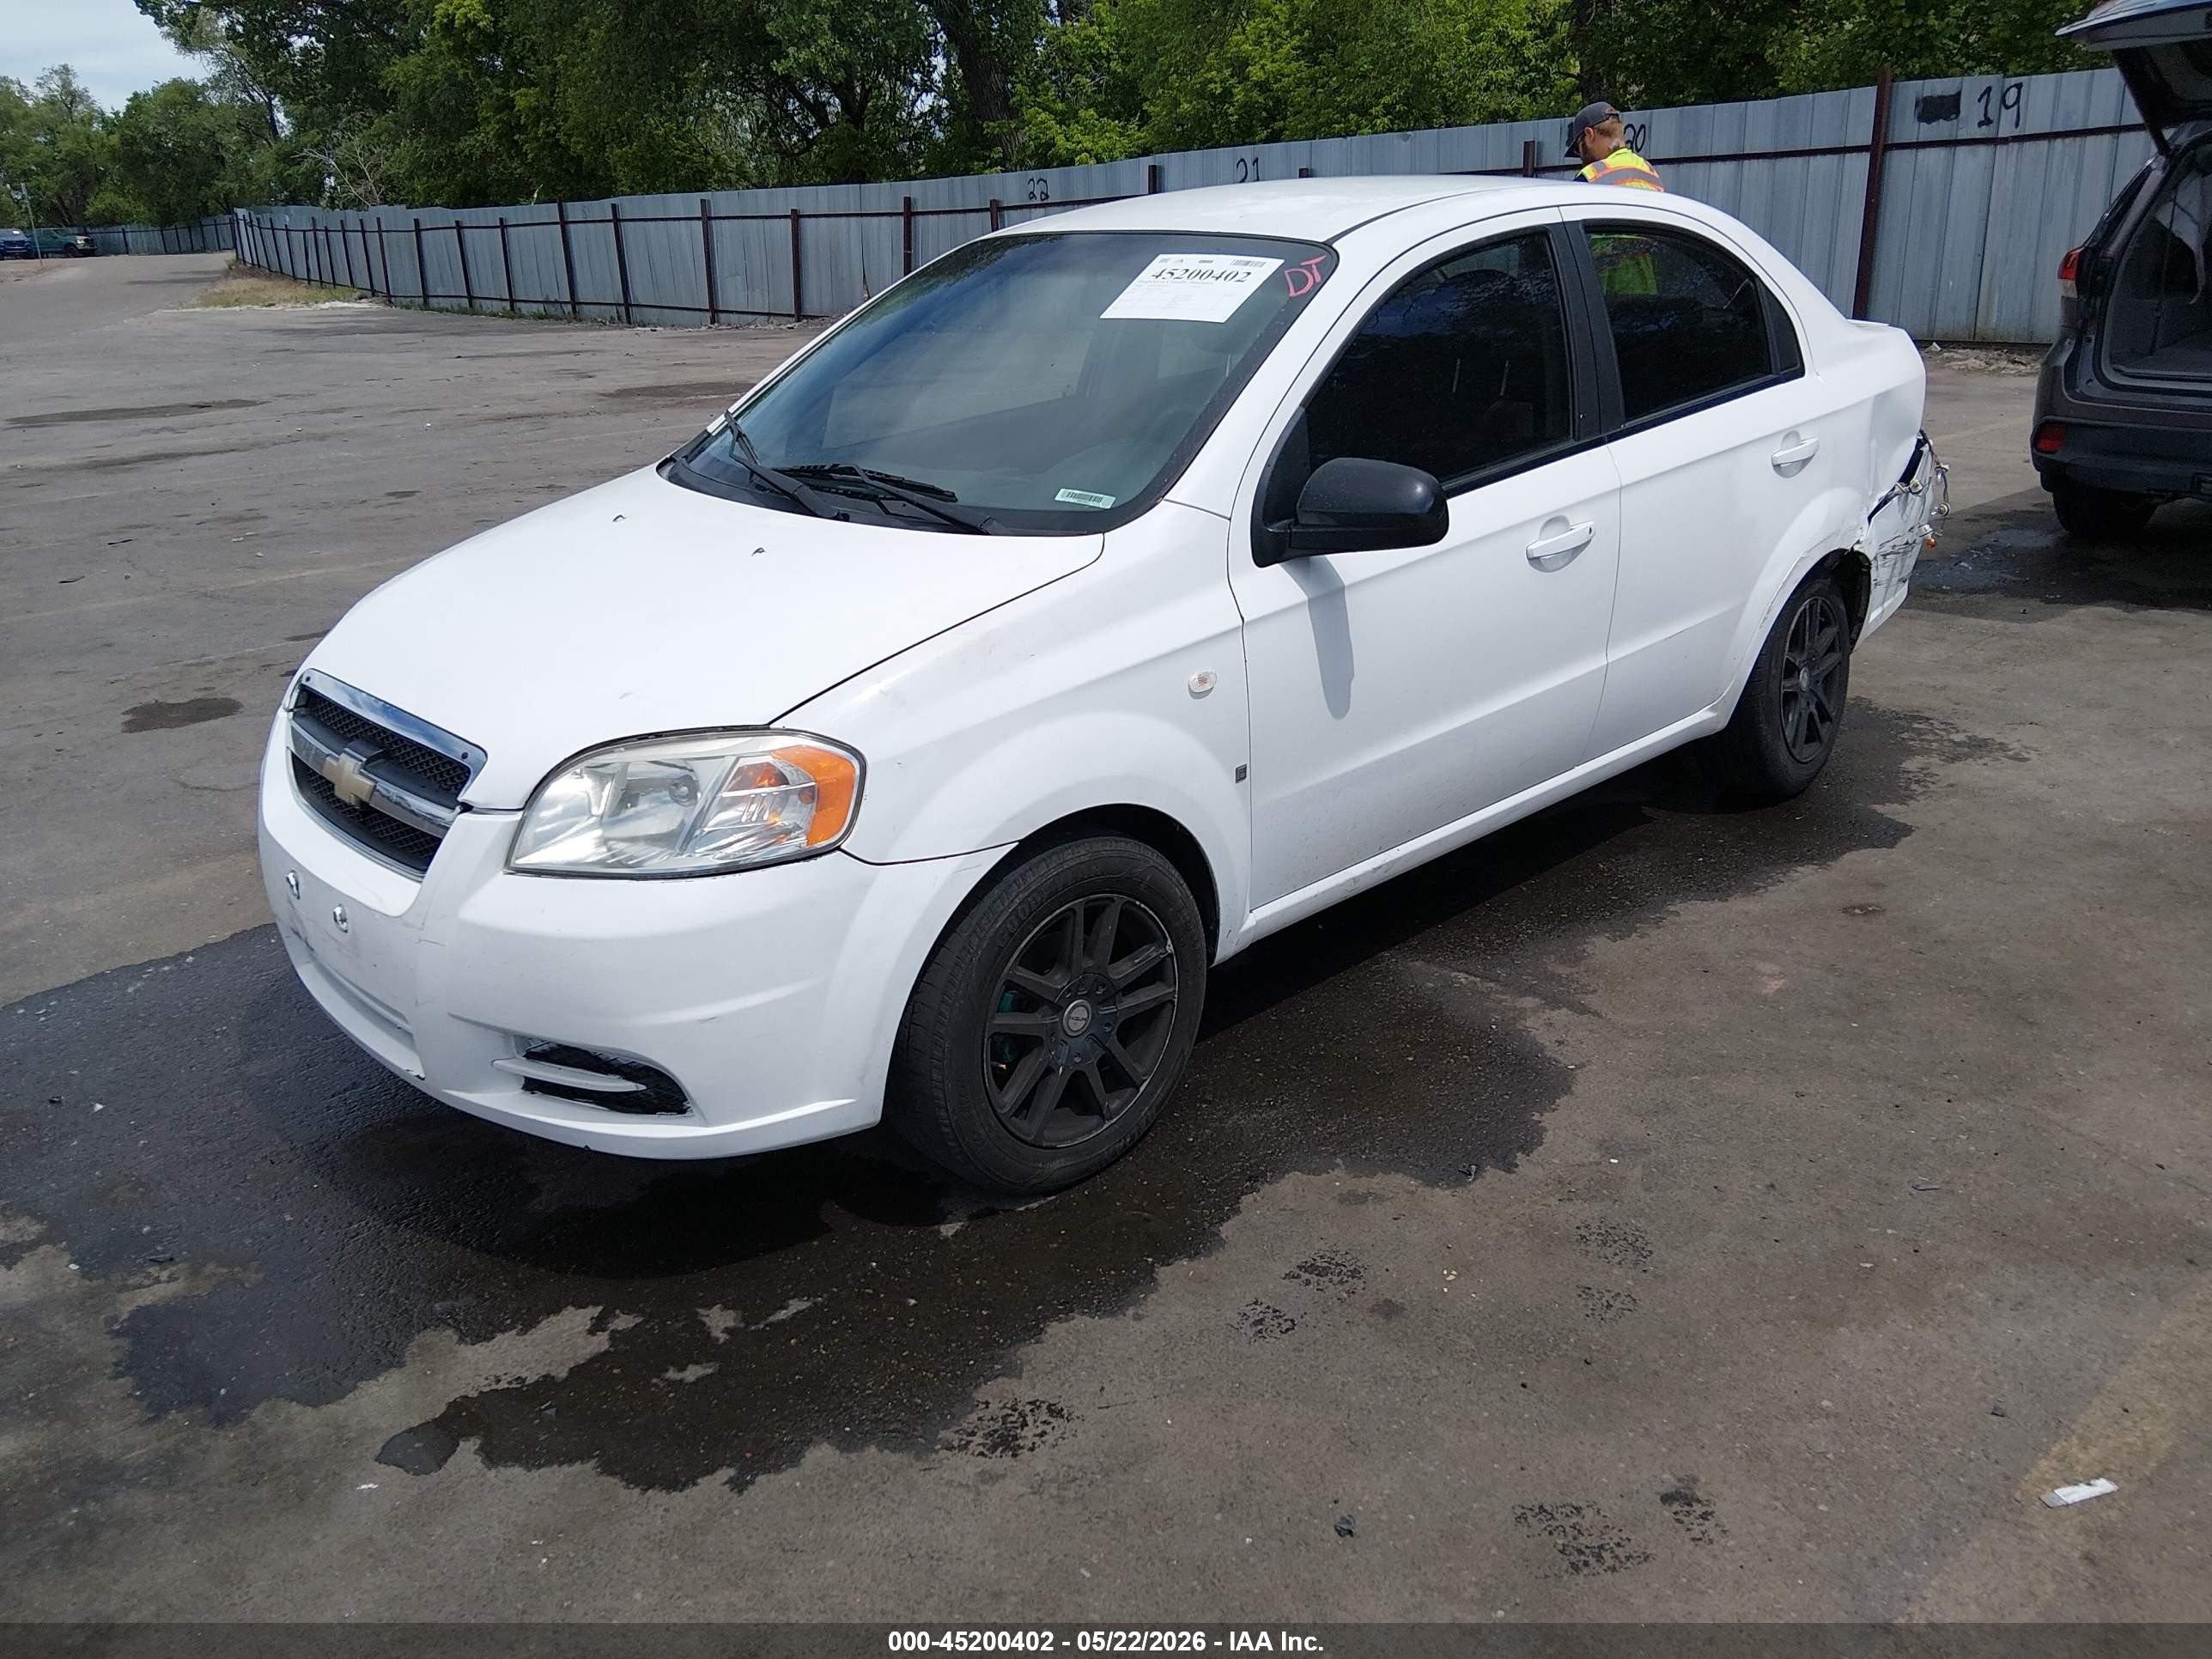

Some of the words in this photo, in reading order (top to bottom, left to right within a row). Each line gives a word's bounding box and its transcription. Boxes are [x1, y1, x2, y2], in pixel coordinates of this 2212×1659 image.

[1978, 82, 2023, 129] 19
[1623, 123, 1646, 153] 20
[1237, 157, 1260, 183] 21
[1028, 178, 1050, 201] 22
[1152, 268, 1252, 283] 45200402
[1284, 255, 1327, 297] DT
